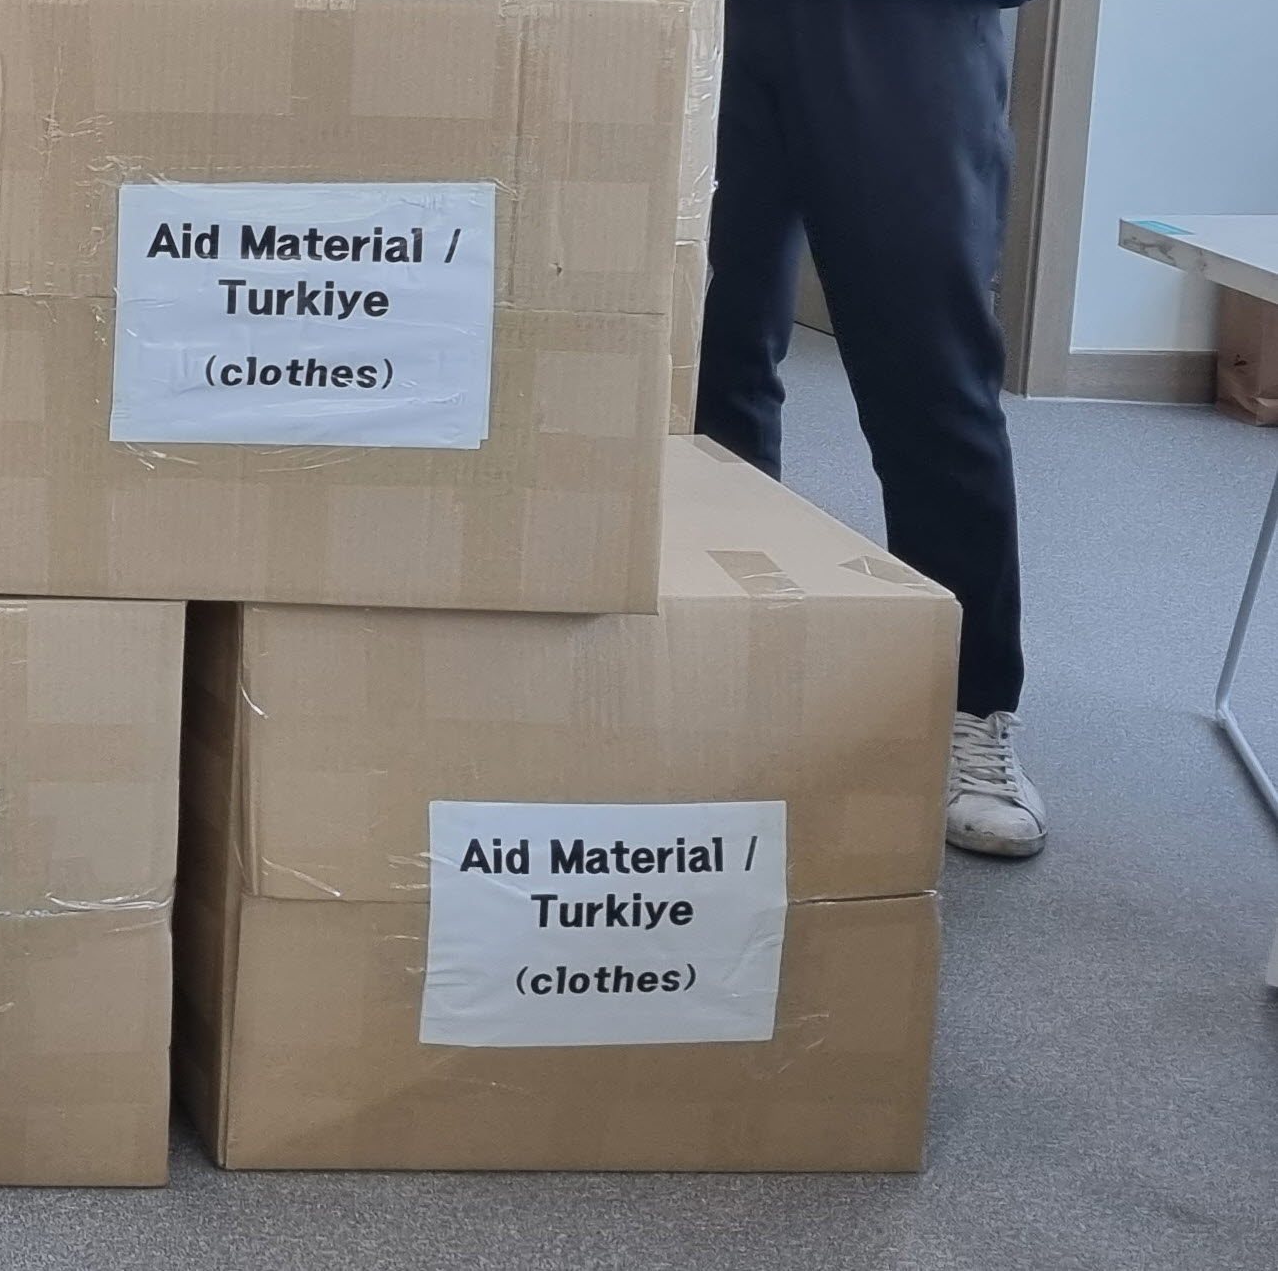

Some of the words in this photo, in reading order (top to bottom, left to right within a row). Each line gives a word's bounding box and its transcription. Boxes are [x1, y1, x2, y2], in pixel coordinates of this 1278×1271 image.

[146, 222, 220, 260] Aid
[240, 224, 423, 263] Material
[443, 228, 462, 264] /
[218, 279, 390, 321] Turkiye
[205, 354, 394, 390] (clothes)
[459, 837, 530, 875] Aid
[549, 836, 724, 875] Material
[744, 835, 758, 872] /
[530, 892, 694, 931] Turkiye
[516, 963, 697, 996] (clothes)
